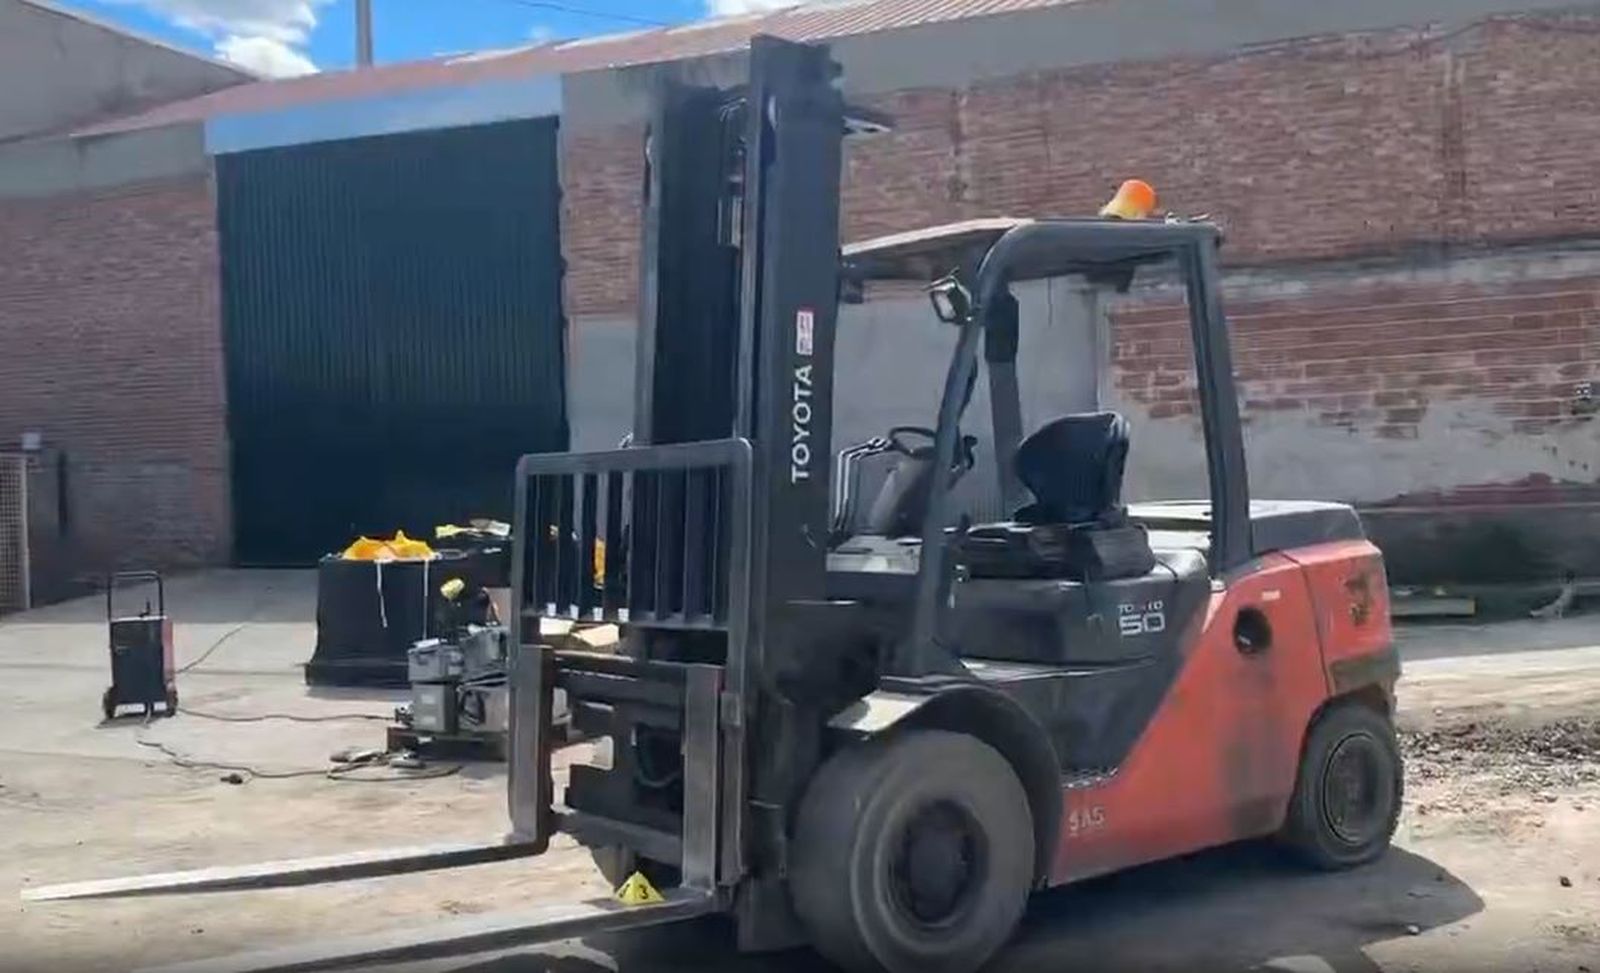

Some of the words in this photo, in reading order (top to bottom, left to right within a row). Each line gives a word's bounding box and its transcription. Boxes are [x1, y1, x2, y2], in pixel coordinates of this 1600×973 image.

[792, 365, 812, 483] TOYOTA
[1119, 612, 1165, 635] 50
[639, 884, 649, 900] 3
